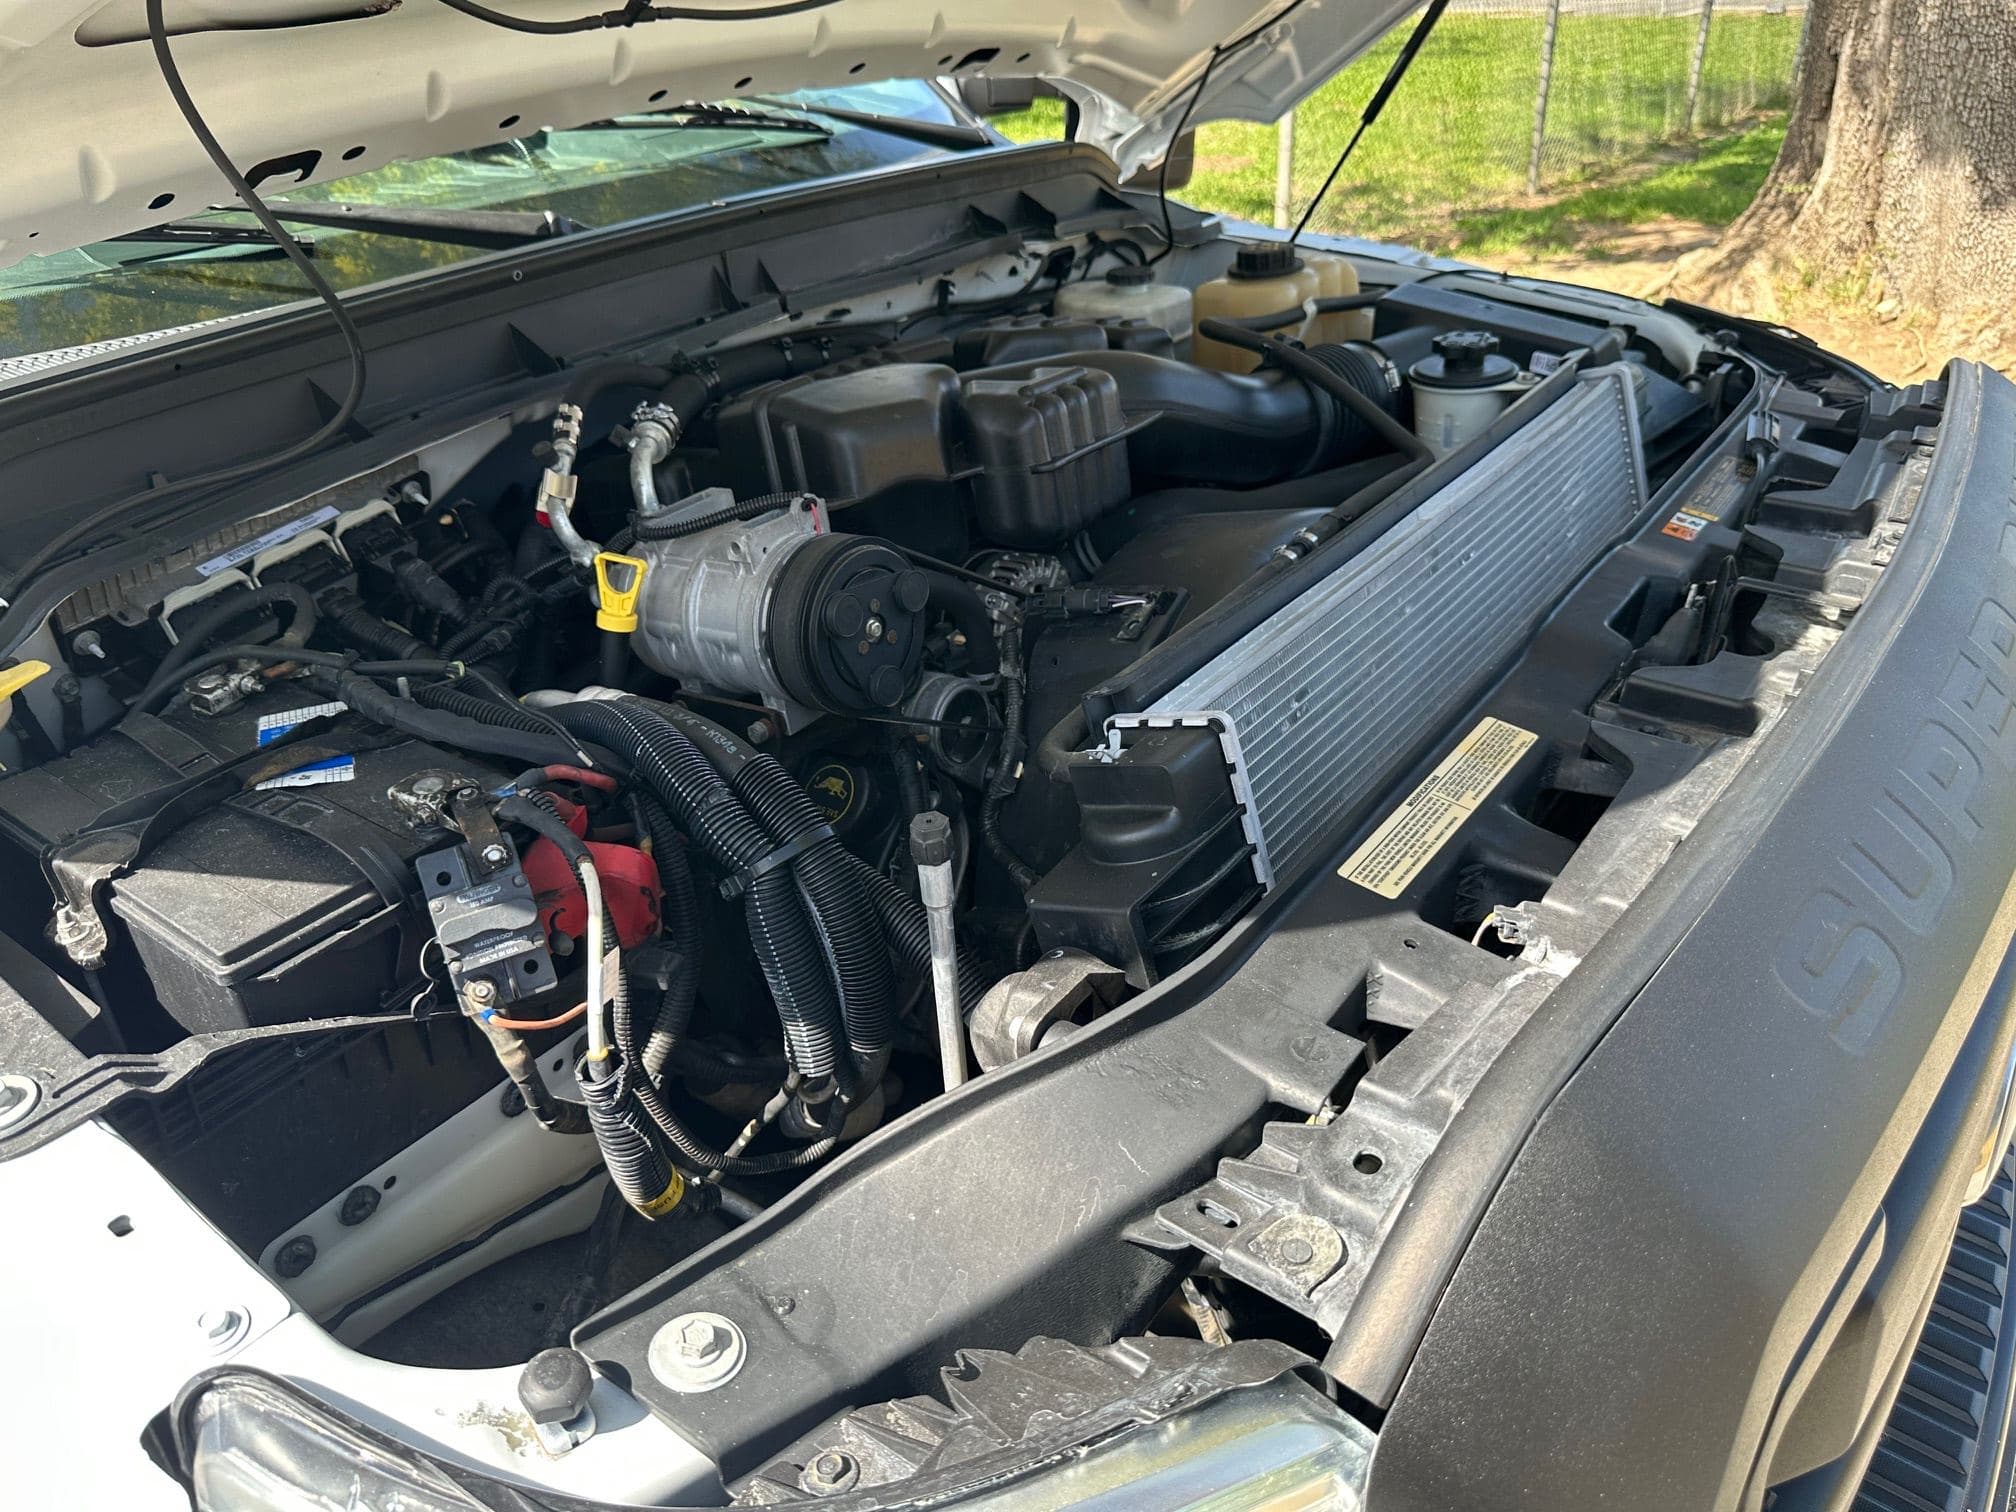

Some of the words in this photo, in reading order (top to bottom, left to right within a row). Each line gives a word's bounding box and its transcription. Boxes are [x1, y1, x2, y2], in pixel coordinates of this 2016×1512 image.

[1407, 774, 1440, 808] MODIFICATIONS
[474, 931, 514, 948] WATERPROOF
[506, 946, 519, 956] USA
